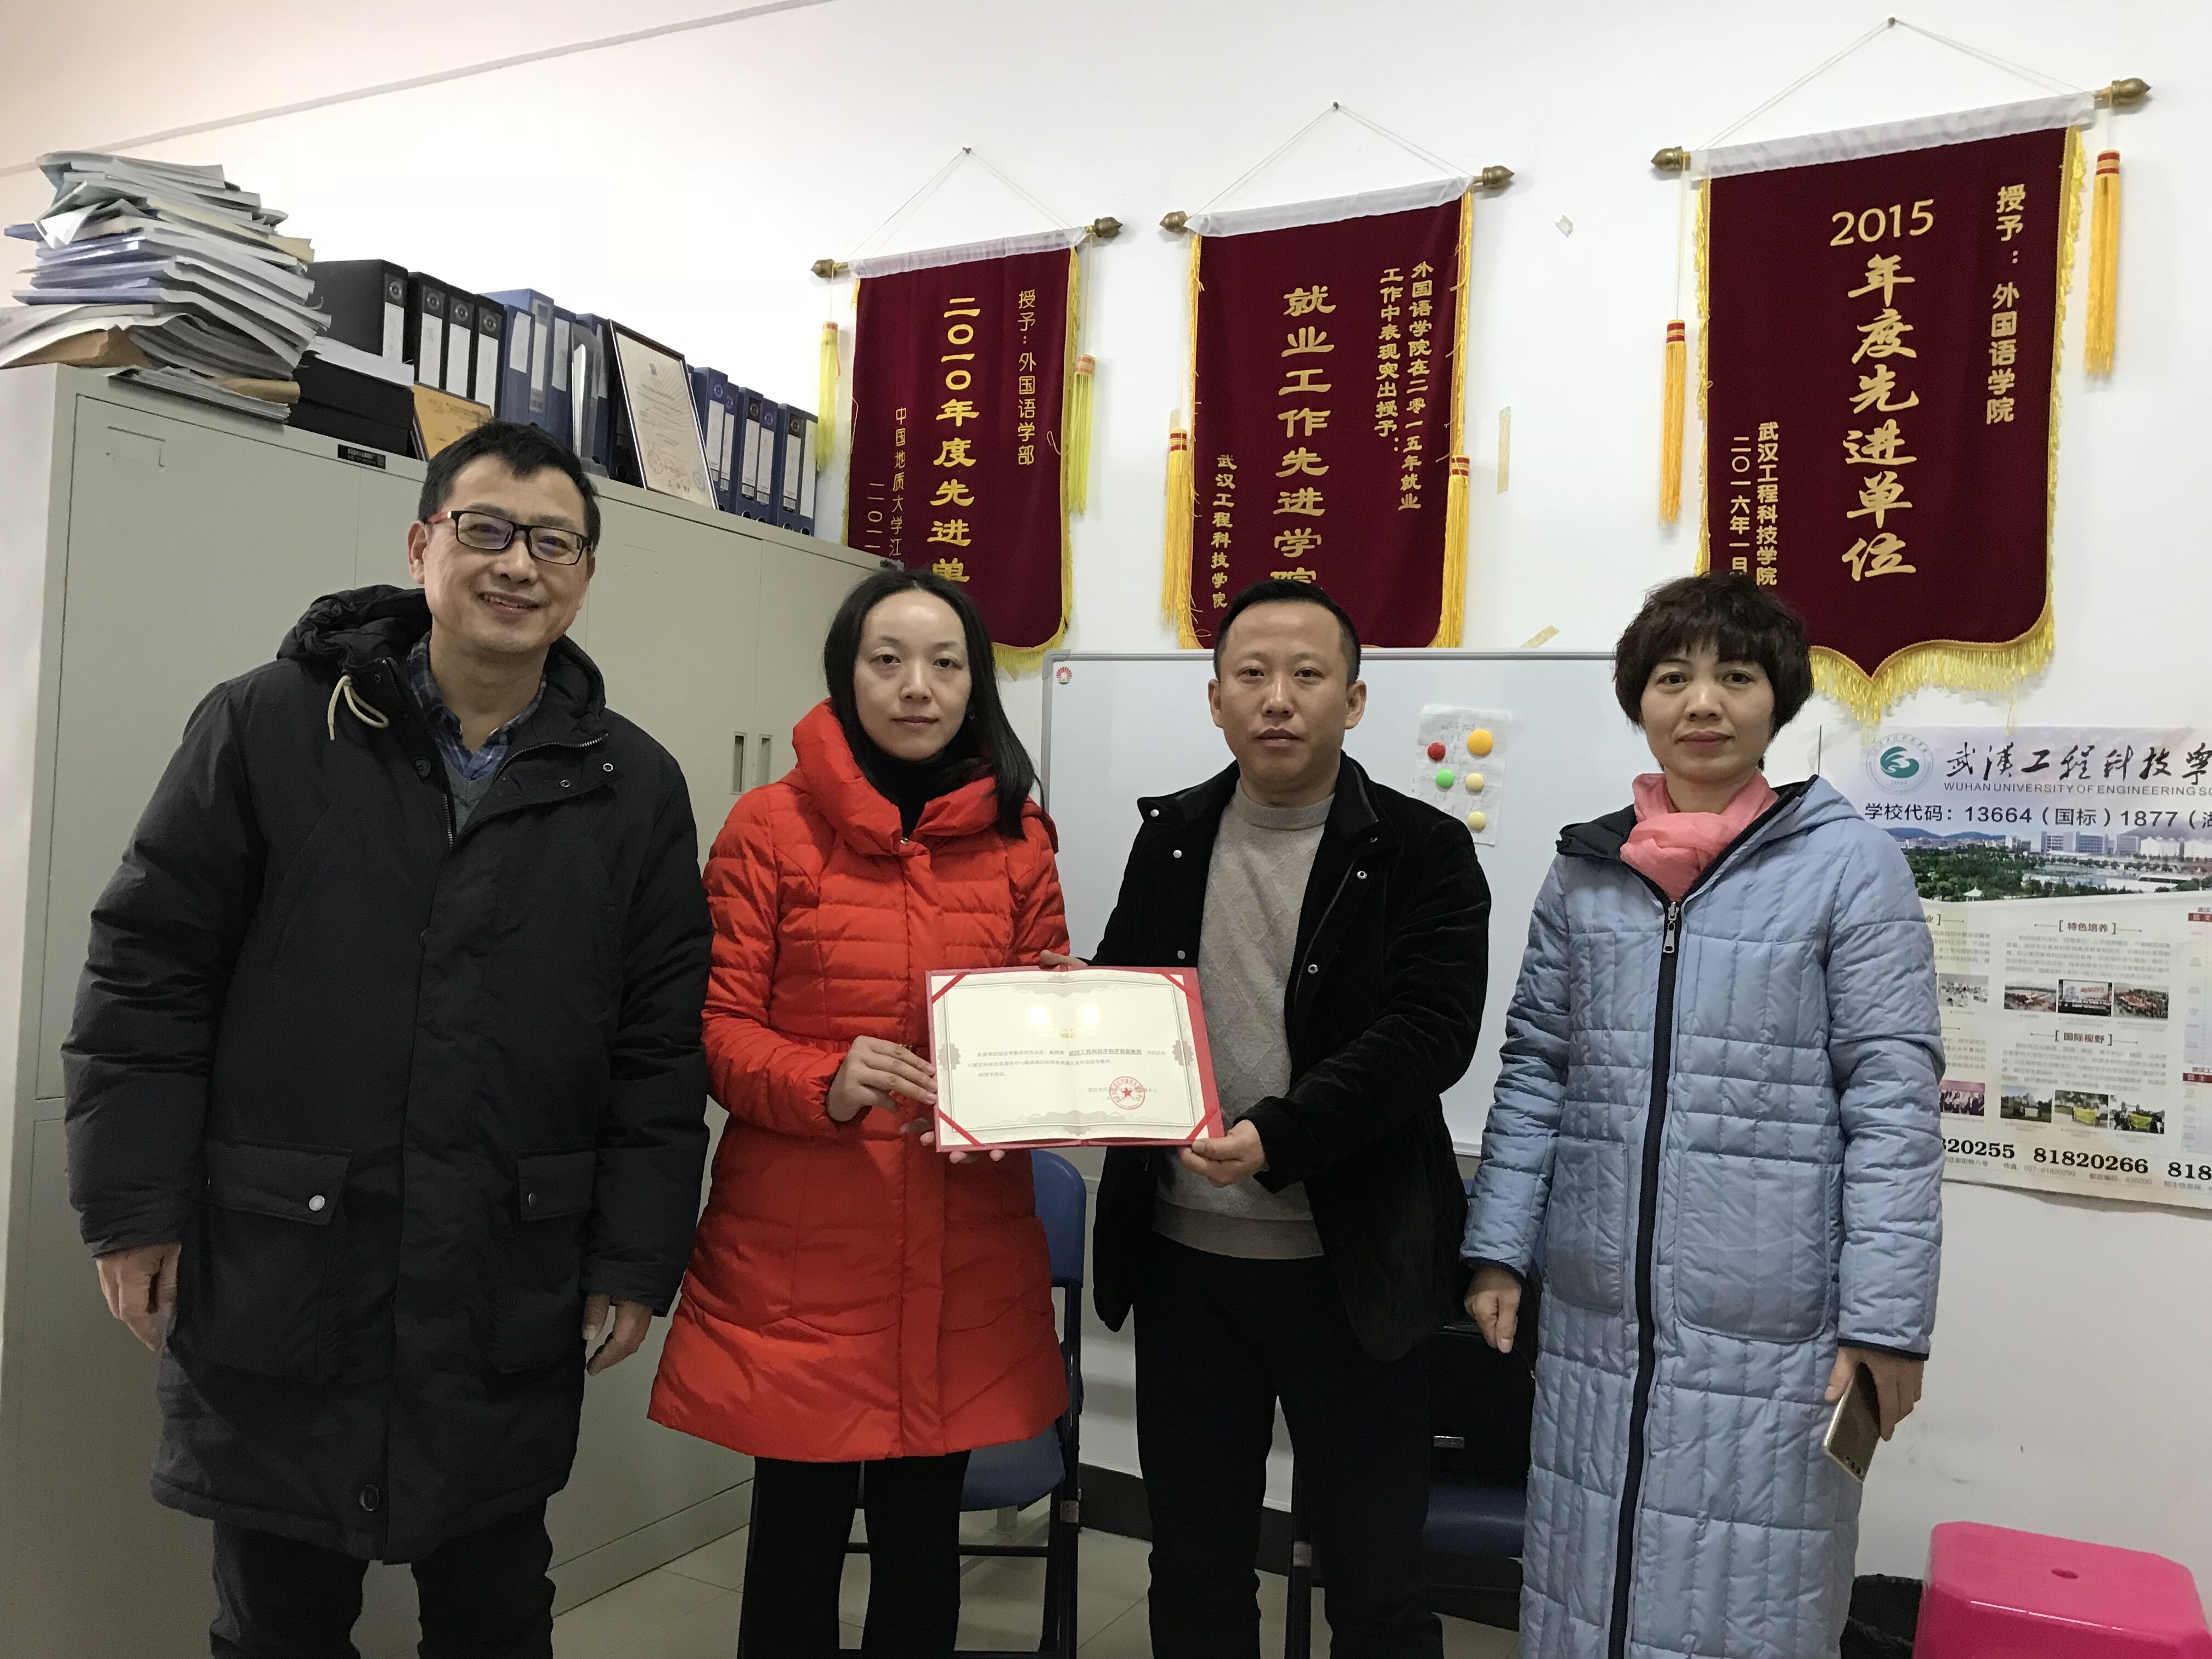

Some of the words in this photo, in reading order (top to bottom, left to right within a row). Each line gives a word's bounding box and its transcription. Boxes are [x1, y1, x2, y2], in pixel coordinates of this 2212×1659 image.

[1830, 198, 1934, 247] 2015
[1398, 260, 1435, 511] 外国语学院在二零一五年就业
[1841, 253, 1920, 582] 年度先进单位
[1210, 454, 1238, 609] 武汉工程科技学院
[1756, 421, 1779, 586] 武汉工程科技学院
[1944, 782, 1991, 792] WUHAN
[1994, 783, 2074, 793] UNIVERSITY
[2076, 784, 2095, 793] OF
[2097, 785, 2196, 796] ENGINEERING
[2033, 1147, 2149, 1174] 81820266
